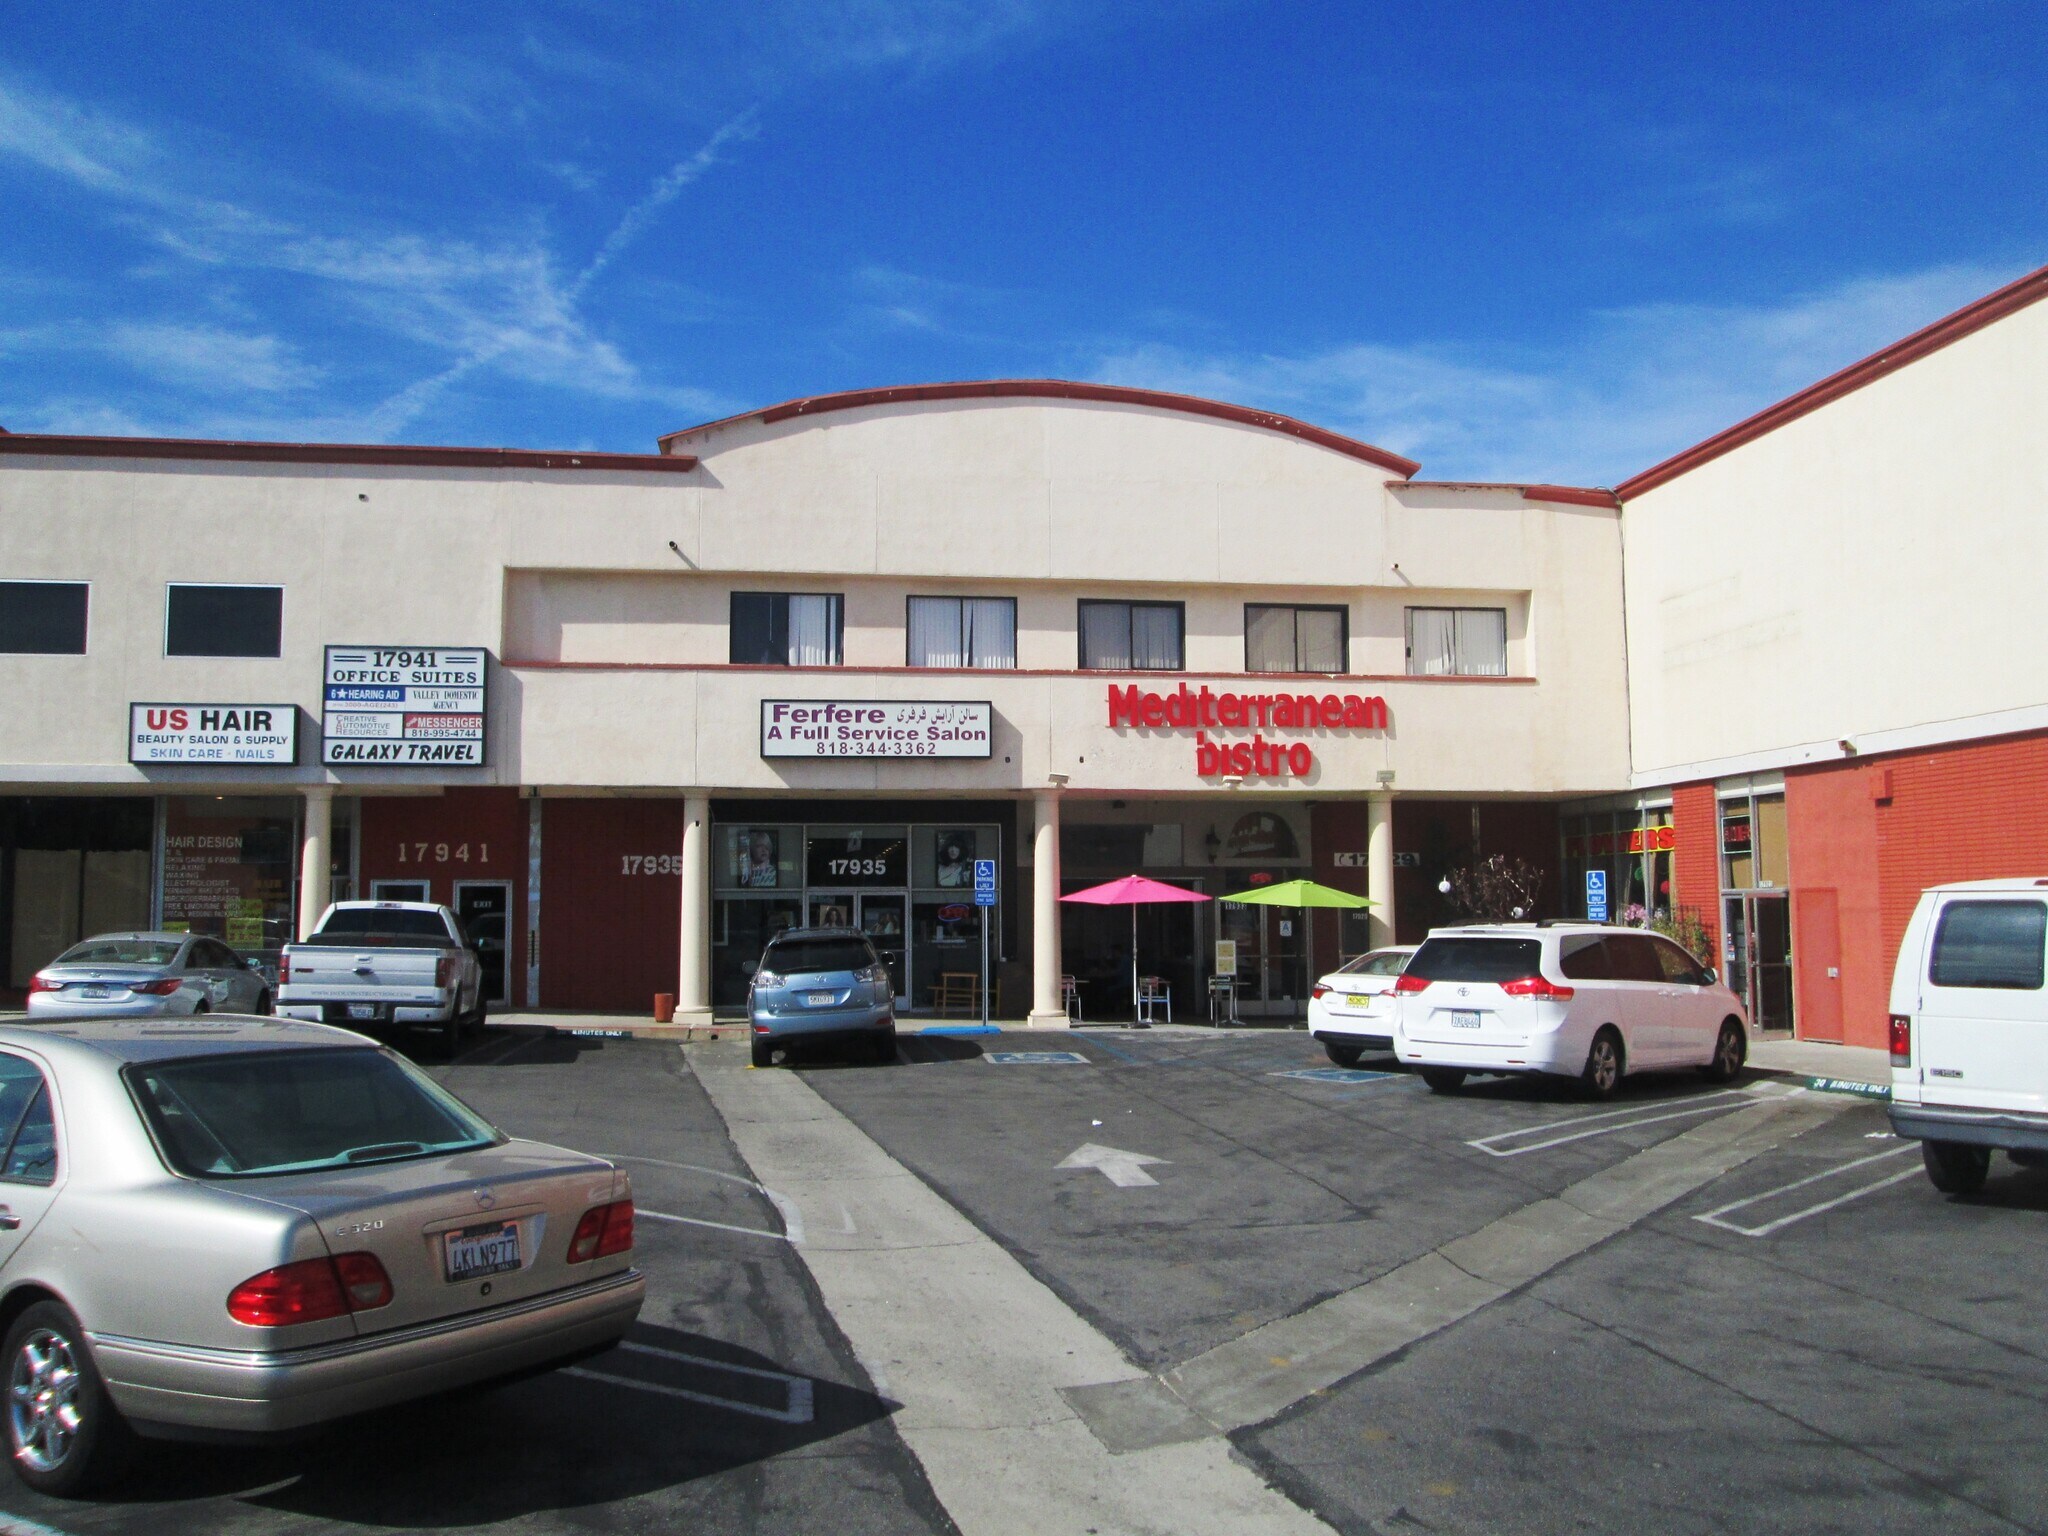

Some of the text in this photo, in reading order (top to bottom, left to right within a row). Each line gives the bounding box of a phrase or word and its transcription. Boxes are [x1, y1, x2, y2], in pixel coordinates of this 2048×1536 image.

[374, 651, 437, 668] 17941
[333, 670, 477, 683] OFFICE SUITES
[349, 689, 384, 699] HEARING
[386, 690, 400, 700] AID
[413, 690, 479, 700] VALLEY DOMESTIC
[432, 701, 459, 709] AGENCY
[1108, 682, 1387, 729] Mediterranean
[147, 709, 272, 731] US HAIR
[336, 714, 377, 722] CREATIVE
[772, 704, 886, 724] Ferfere
[417, 717, 482, 728] MESSENGER
[336, 728, 388, 736] RESOURCES
[412, 729, 476, 738] 818-995-4744
[768, 726, 986, 741] A Full Service Salon
[137, 735, 288, 745] BEAUTY SALON & SUPPLY
[150, 748, 275, 759] SKIN CARE NAILS
[331, 744, 474, 761] GALAXY TRAVEL
[1196, 731, 1312, 777] bistro
[166, 837, 243, 848] HAIR DESIGN
[399, 843, 489, 863] 17941
[621, 855, 683, 875] 17935
[829, 859, 886, 875] 17935
[473, 901, 492, 909] EXIT
[1829, 1081, 1866, 1091] MINUTES
[1868, 1085, 1889, 1094] ONLY
[351, 1220, 383, 1234] 320
